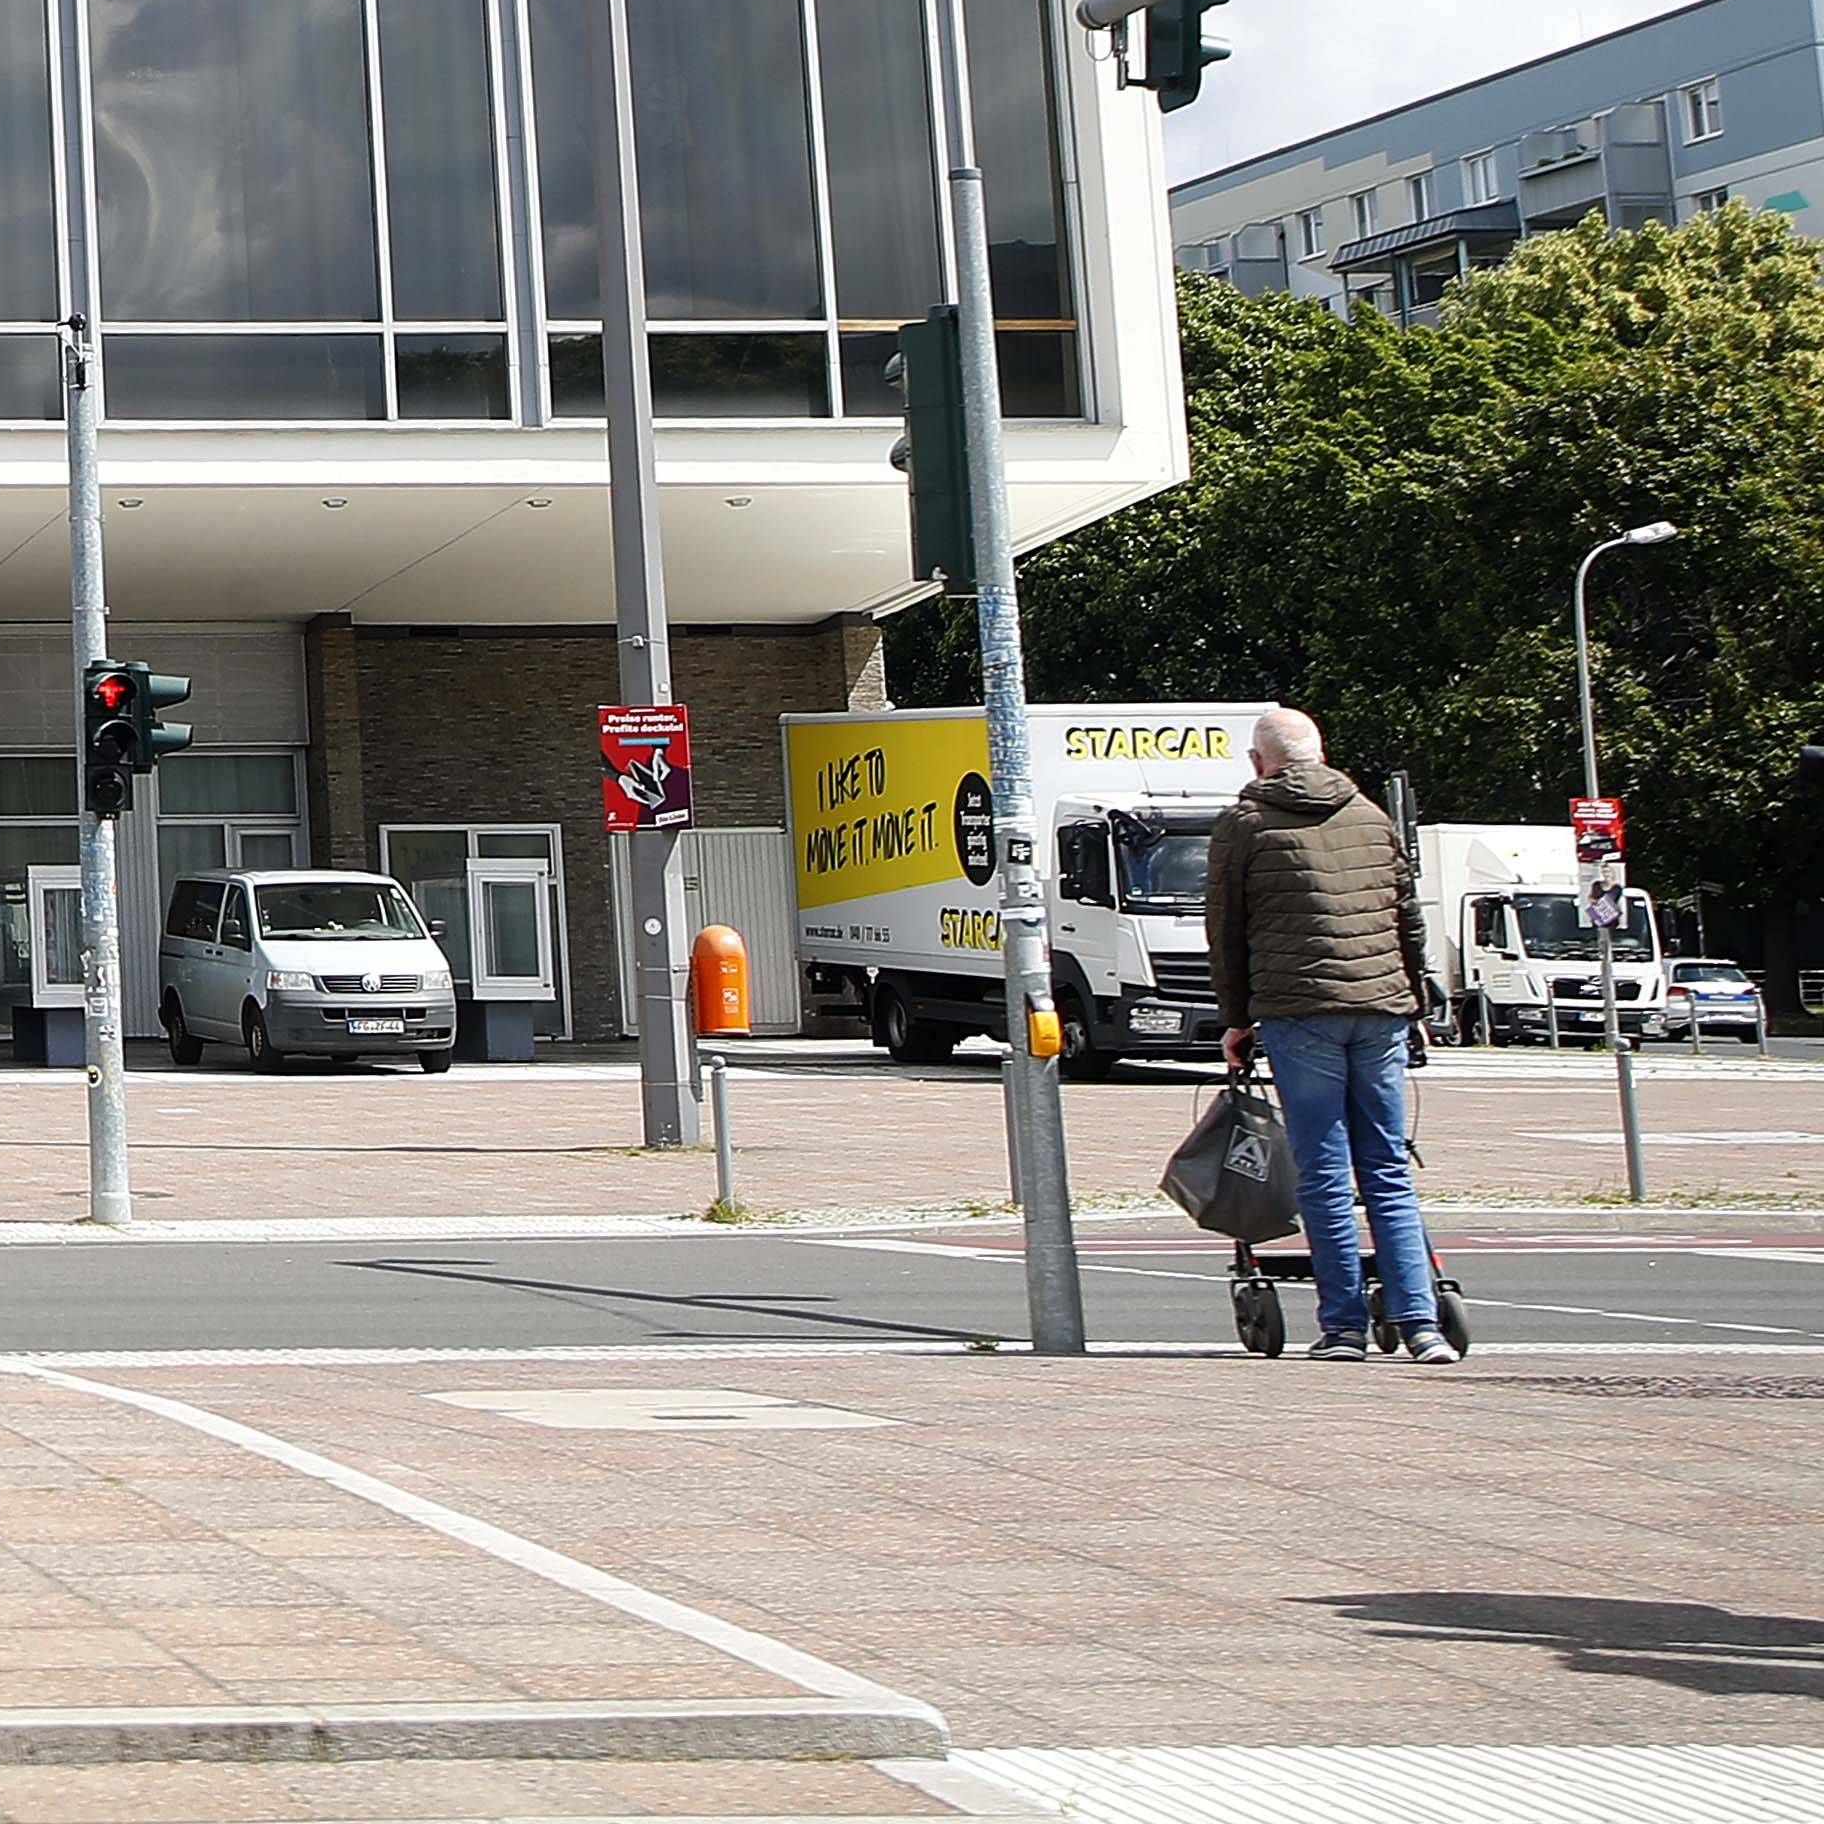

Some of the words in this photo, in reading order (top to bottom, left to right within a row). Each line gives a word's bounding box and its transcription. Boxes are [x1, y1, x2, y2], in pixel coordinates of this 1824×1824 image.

[1065, 726, 1234, 760] STARCAR
[816, 770, 825, 813] I
[827, 753, 862, 811] LIKE
[863, 746, 887, 798] TO
[805, 822, 848, 874] MOVE
[871, 807, 917, 862] MOVE
